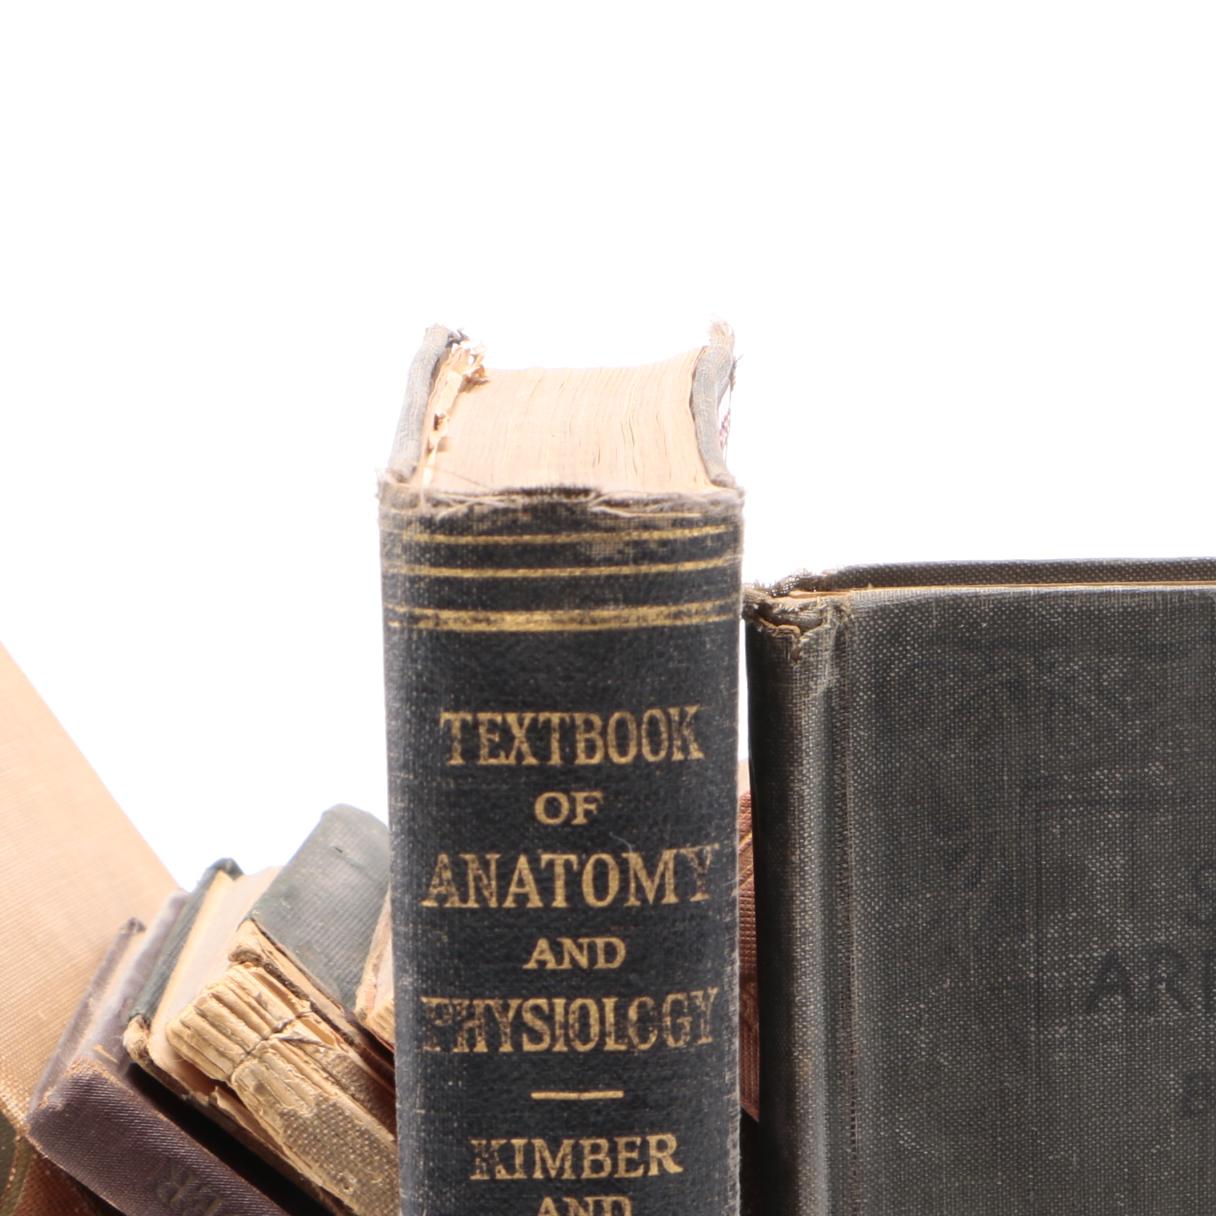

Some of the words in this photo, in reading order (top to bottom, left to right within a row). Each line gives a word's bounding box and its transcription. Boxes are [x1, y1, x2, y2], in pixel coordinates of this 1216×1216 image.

[439, 705, 704, 766] TEXTBOOK
[534, 791, 604, 826] OF
[421, 843, 721, 909] ANATOMY
[523, 936, 628, 970] AND
[419, 986, 720, 1054] PHYSIOLOGY
[469, 1133, 684, 1181] KIMBER
